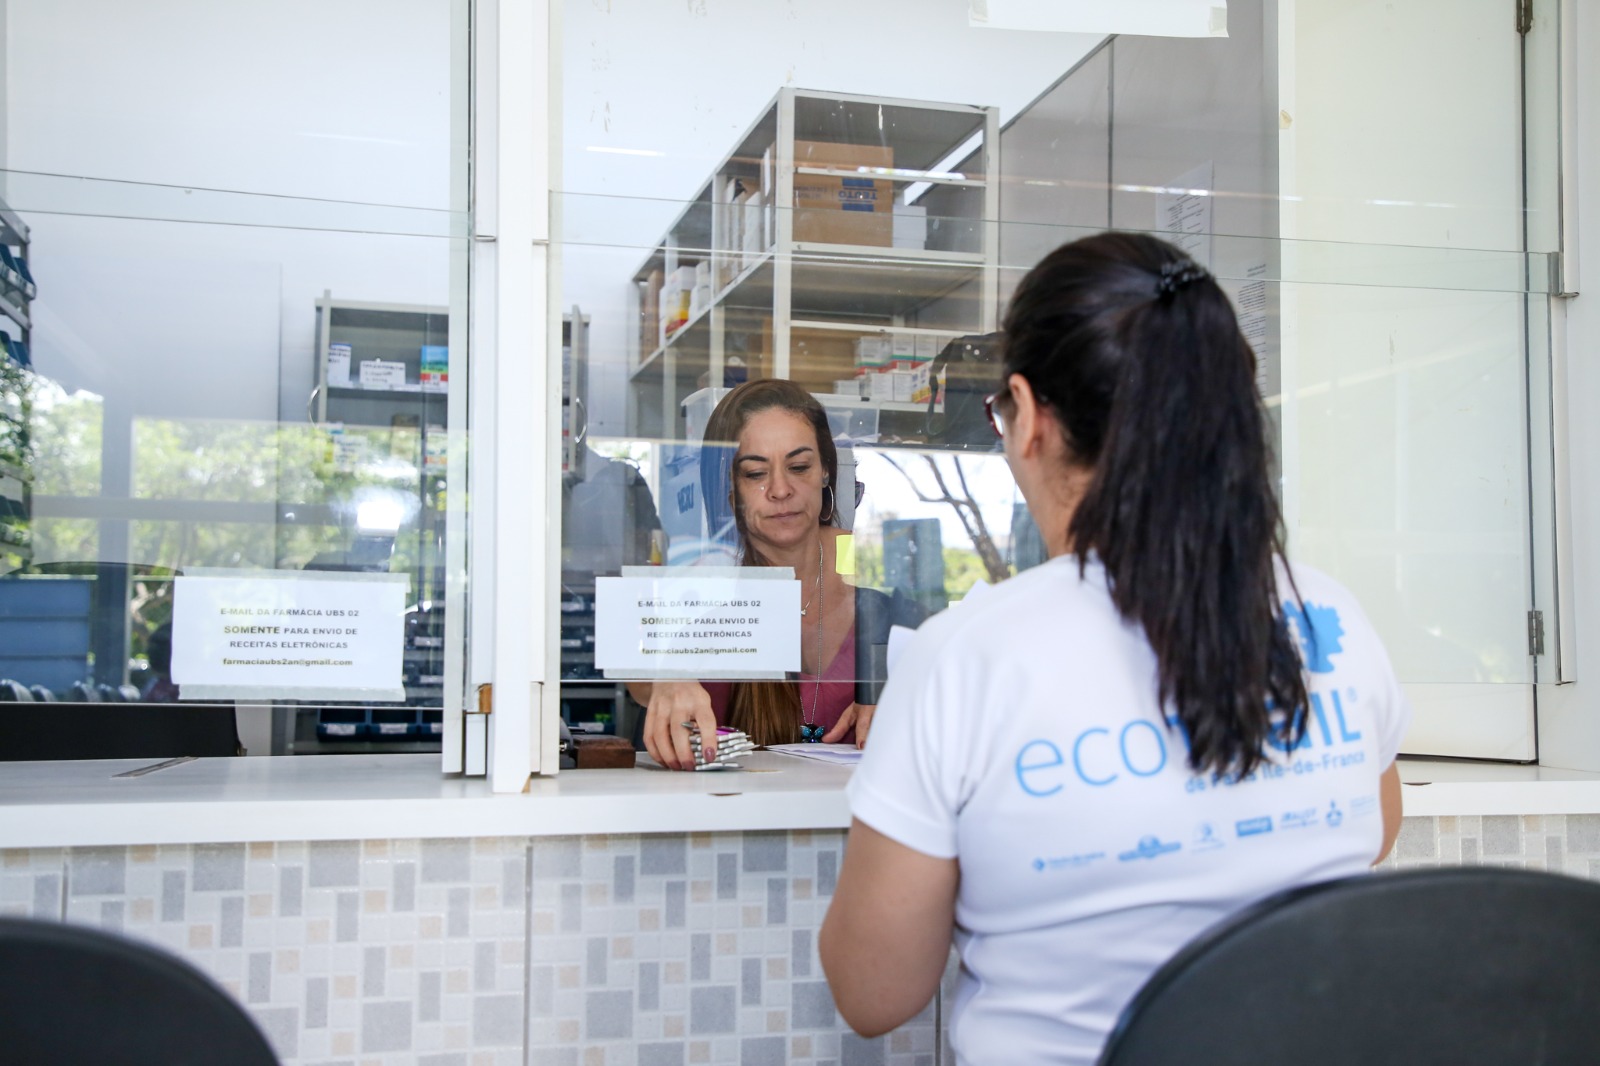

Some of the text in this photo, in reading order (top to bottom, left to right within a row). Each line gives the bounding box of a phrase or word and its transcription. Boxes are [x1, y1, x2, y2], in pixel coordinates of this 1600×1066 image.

[838, 190, 877, 200] TEUTO
[638, 600, 667, 608] E-MAIL
[670, 600, 681, 608] DA
[220, 607, 359, 617] E-MAIL DA FARMÁCIA UBS 02
[641, 617, 692, 625] SOMENTE
[719, 617, 746, 625] ENVIO
[748, 617, 759, 625] DE
[224, 625, 280, 634] SOMENTE
[283, 627, 309, 635] PARA
[312, 627, 342, 635] ENVIO
[692, 630, 752, 638] ELETRÔNICAS
[281, 640, 348, 649] ELETRÔNICAS
[642, 647, 757, 655] farmaciaubs2an@gmail.com
[223, 658, 352, 667] farmaciaubs2an@gmail.com
